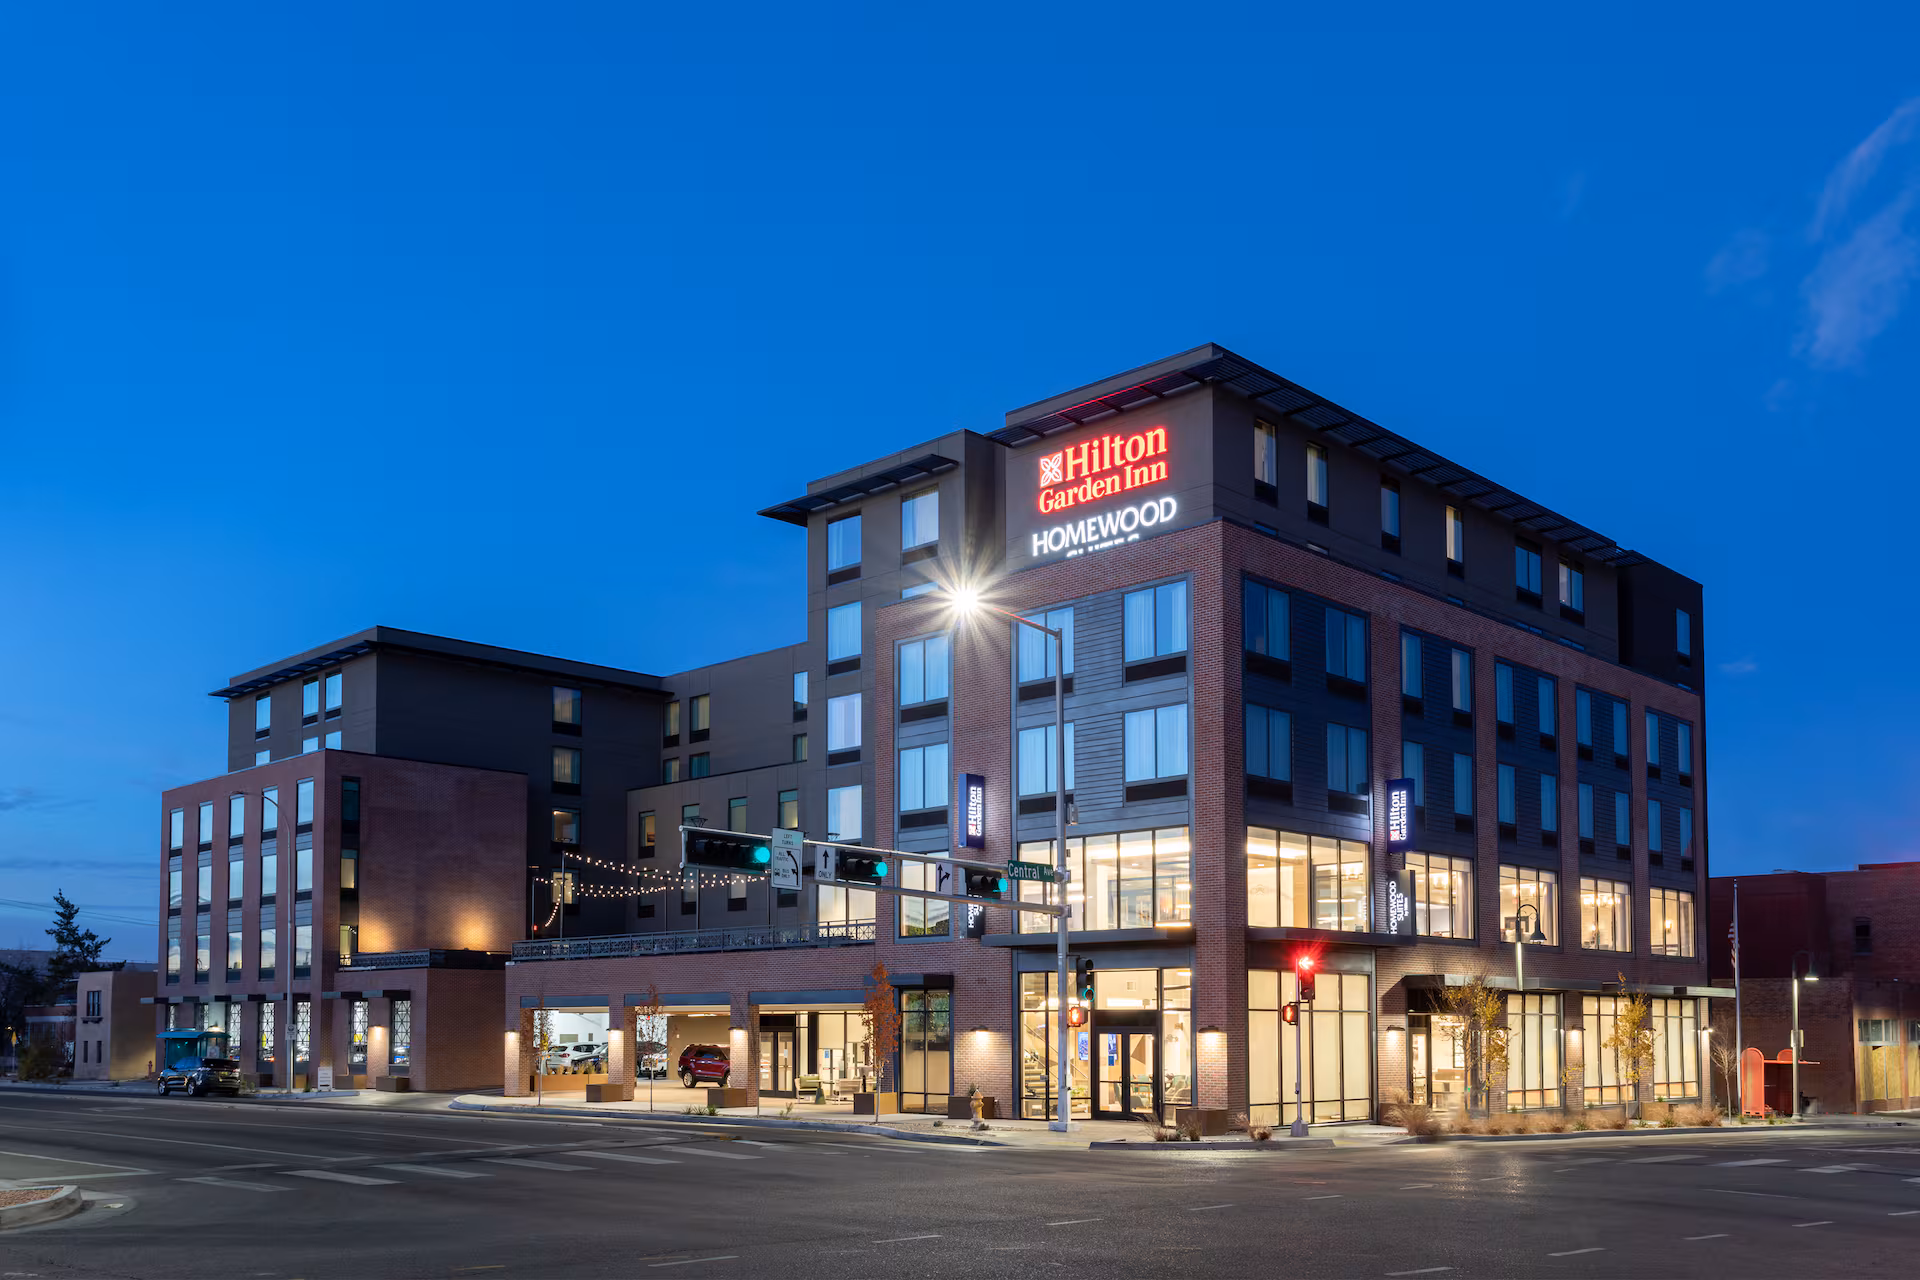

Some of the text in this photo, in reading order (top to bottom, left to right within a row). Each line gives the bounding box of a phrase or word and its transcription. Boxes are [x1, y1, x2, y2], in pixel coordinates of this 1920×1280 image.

[1065, 427, 1167, 481] Hilton
[1039, 461, 1168, 513] Garden Inn
[1032, 497, 1177, 557] HOMEWOOD
[968, 786, 976, 824] Hilton
[1390, 791, 1400, 830] Hilton
[818, 870, 832, 879] ONLY
[1008, 862, 1054, 879] Central Ave
[1396, 892, 1404, 921] SUITES
